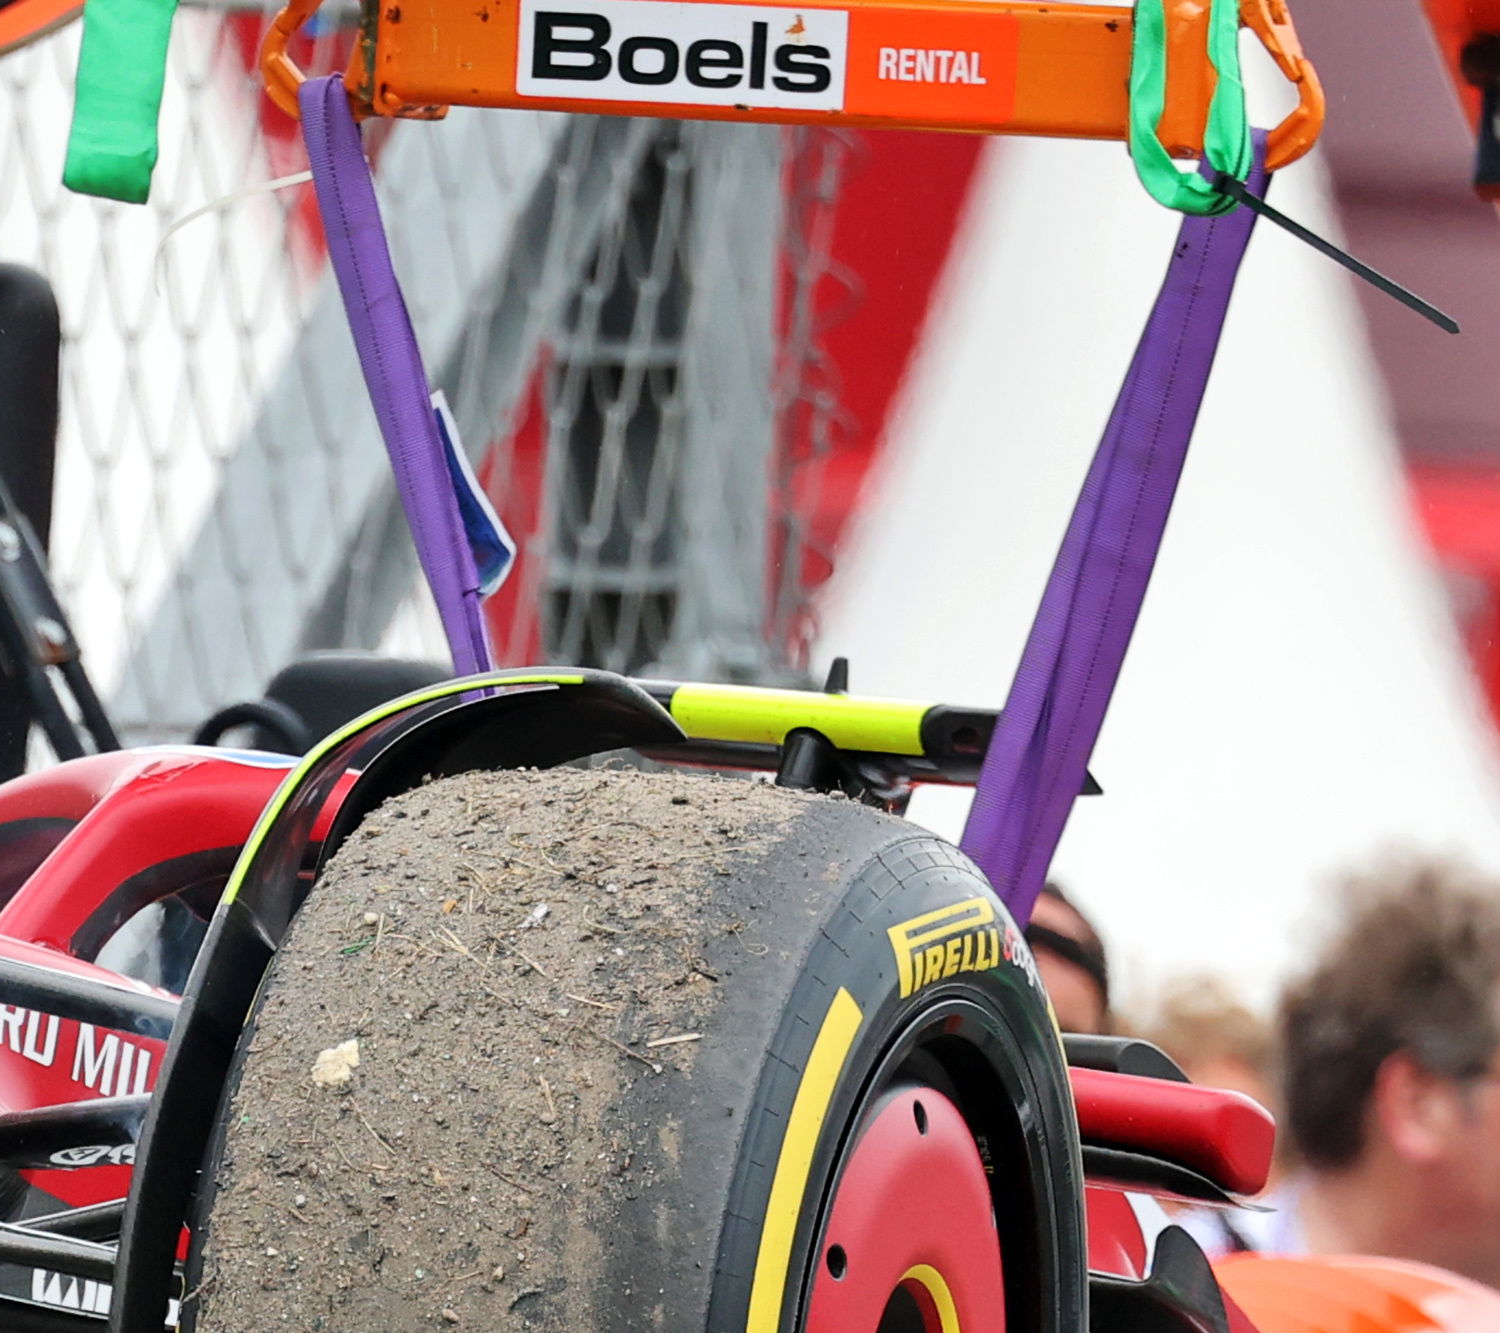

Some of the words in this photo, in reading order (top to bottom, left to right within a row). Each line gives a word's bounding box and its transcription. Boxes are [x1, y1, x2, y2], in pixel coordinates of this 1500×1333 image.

[531, 11, 832, 94] Boels
[878, 47, 986, 86] RENTAL
[887, 896, 1000, 1000] PIRELLI
